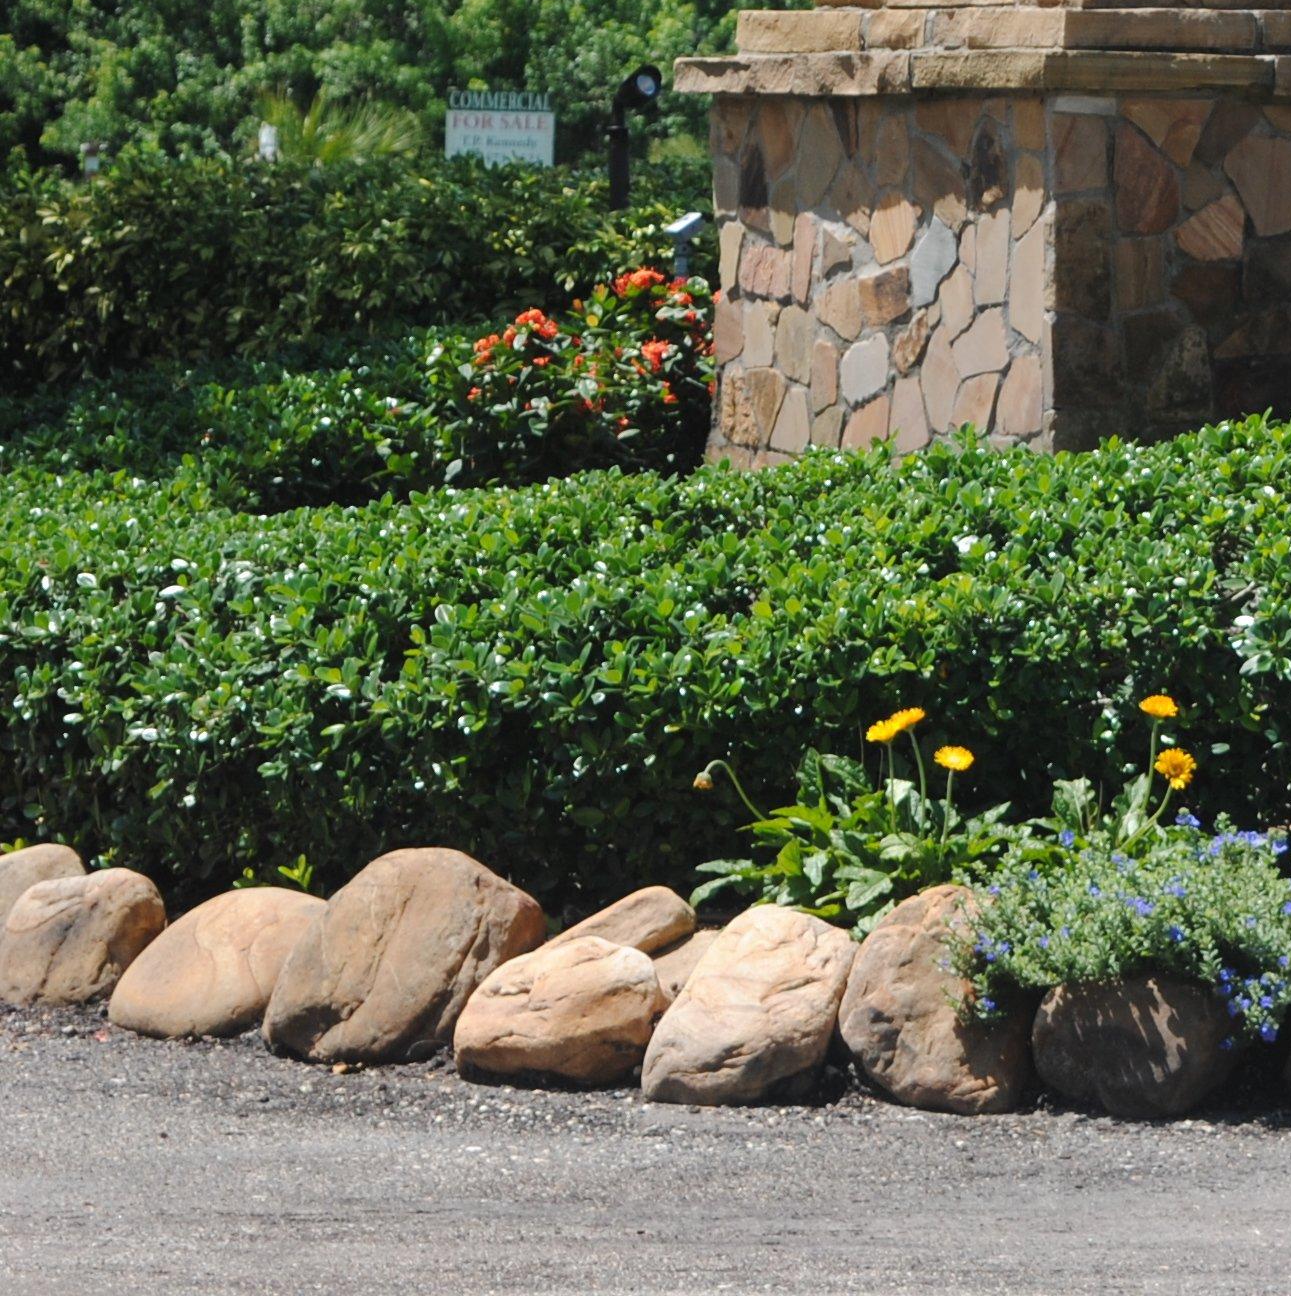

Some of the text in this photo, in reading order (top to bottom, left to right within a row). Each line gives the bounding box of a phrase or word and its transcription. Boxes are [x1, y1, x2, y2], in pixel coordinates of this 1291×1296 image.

[450, 90, 552, 111] COMMERCIAL
[453, 113, 549, 131] FOR SALE
